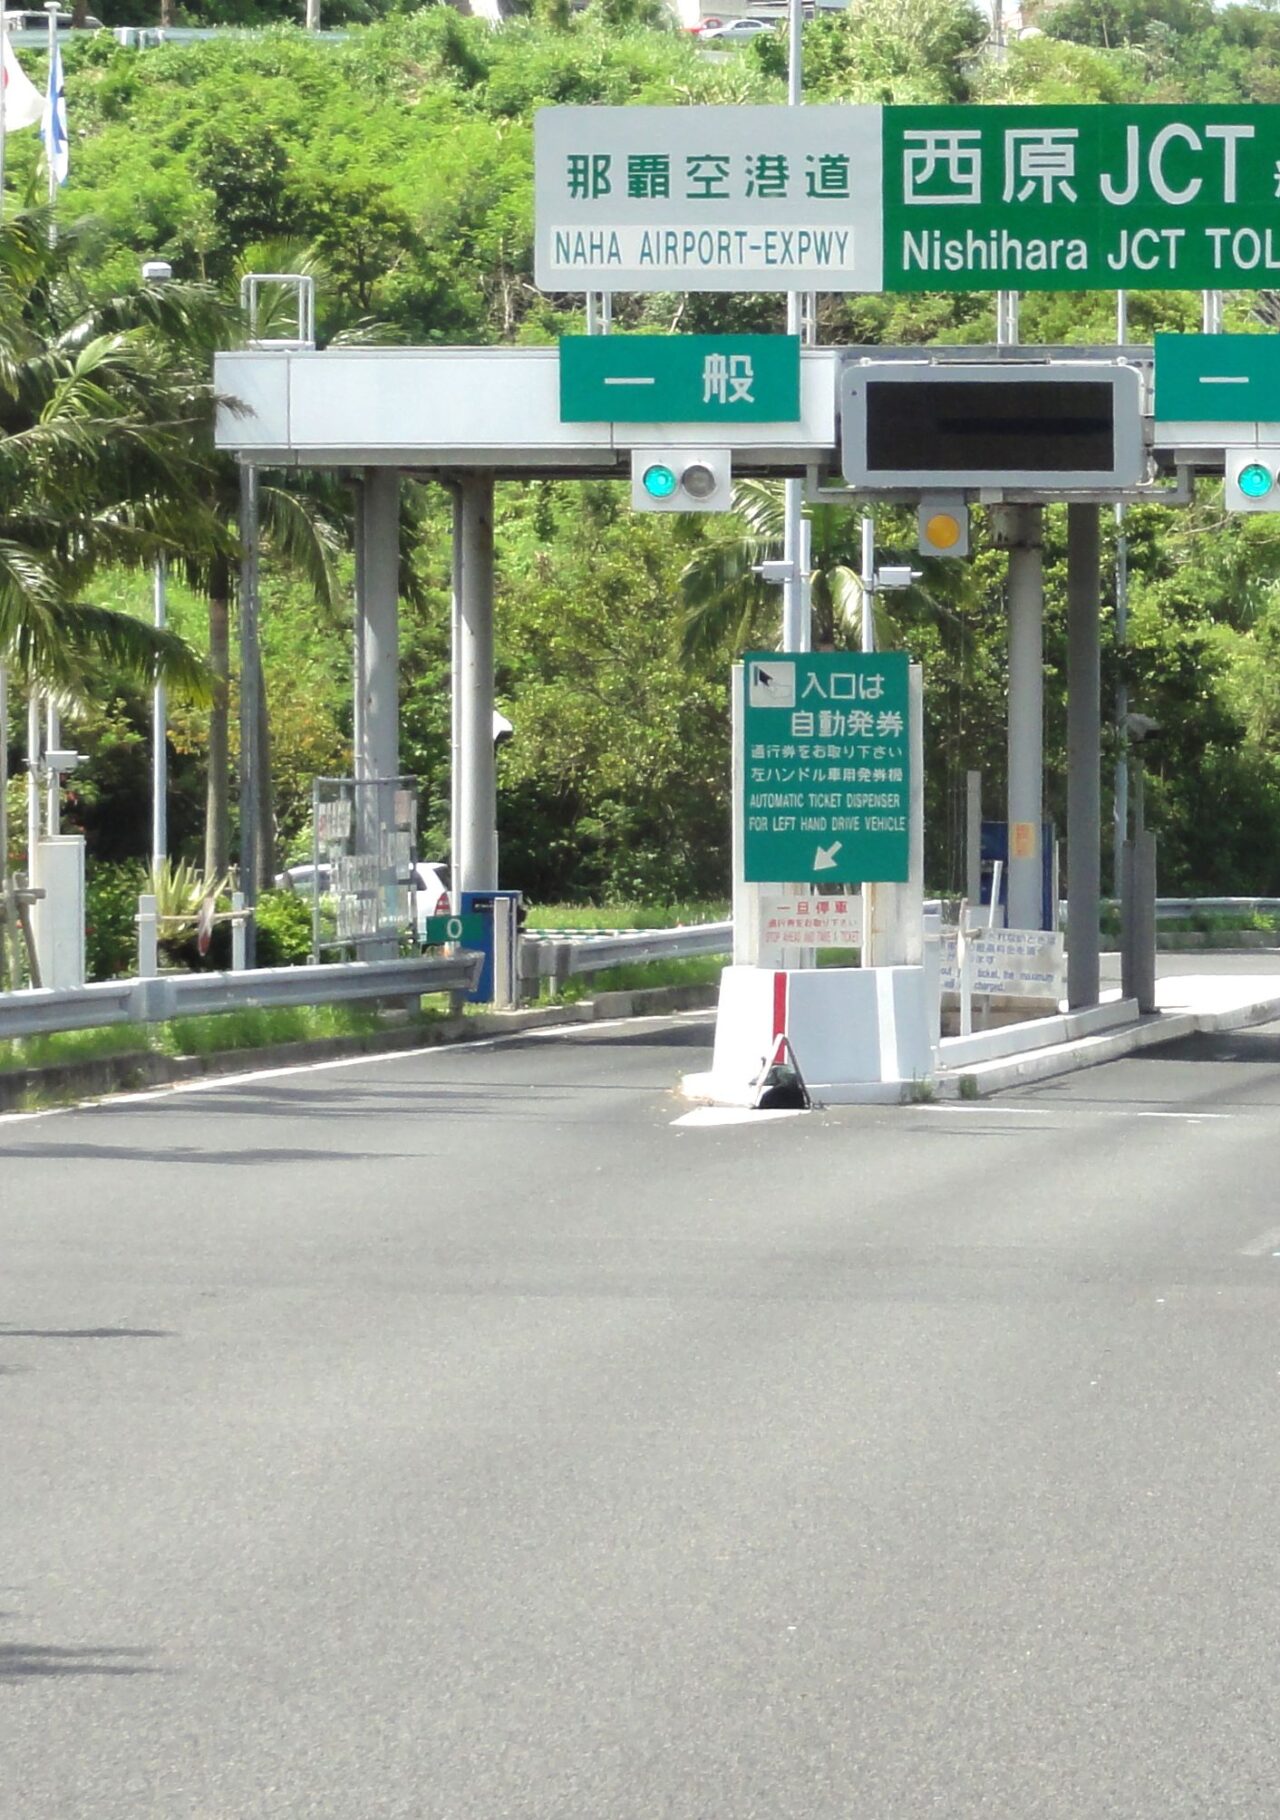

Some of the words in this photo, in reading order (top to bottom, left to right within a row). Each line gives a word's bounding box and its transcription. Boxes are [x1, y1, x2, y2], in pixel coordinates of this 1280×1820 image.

[567, 154, 850, 200] 那覇空港道
[555, 231, 622, 265] NAHA
[640, 231, 849, 265] AIRPORT-EXPWY
[903, 229, 1088, 270] Nishihara
[1107, 228, 1185, 270] JCT
[604, 353, 755, 404] 一般
[801, 672, 885, 700] 入口は
[791, 710, 904, 738] 自動発券
[750, 793, 804, 809] AUTOMATIC
[808, 793, 842, 809] TICKET
[846, 793, 900, 809] DISPENSER
[749, 816, 768, 832] FOR
[772, 816, 797, 832] LEFT
[800, 816, 827, 832] HAND
[831, 816, 860, 832] DRIVE
[864, 816, 906, 832] VEHICLE
